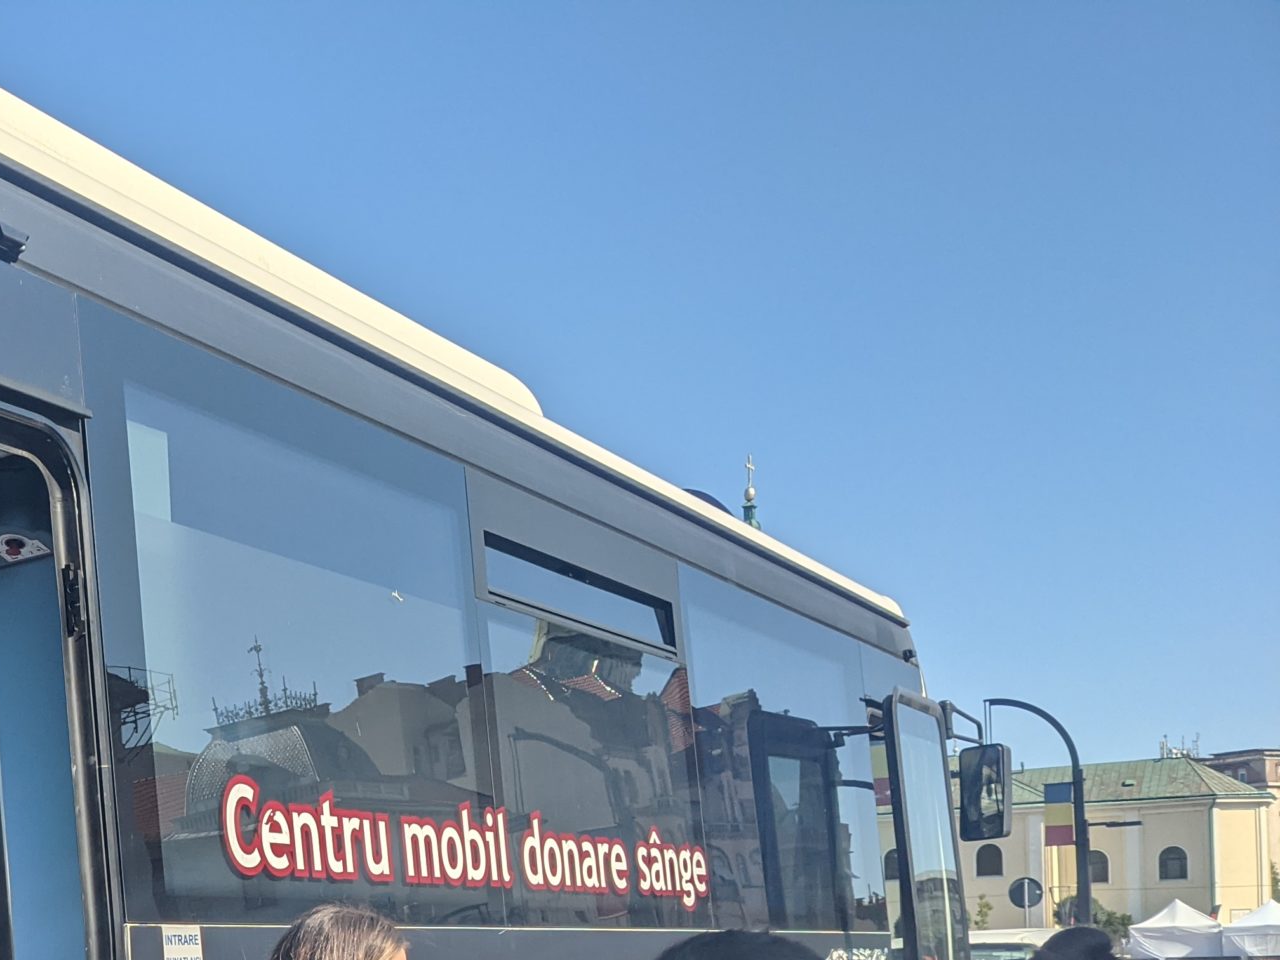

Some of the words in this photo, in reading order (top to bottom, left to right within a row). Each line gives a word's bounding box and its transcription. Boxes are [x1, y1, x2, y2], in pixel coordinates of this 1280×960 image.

[225, 779, 390, 876] Centru
[402, 807, 511, 884] mobil
[522, 817, 628, 891] donare
[636, 829, 708, 908] sânge
[164, 934, 200, 945] INTRARE
